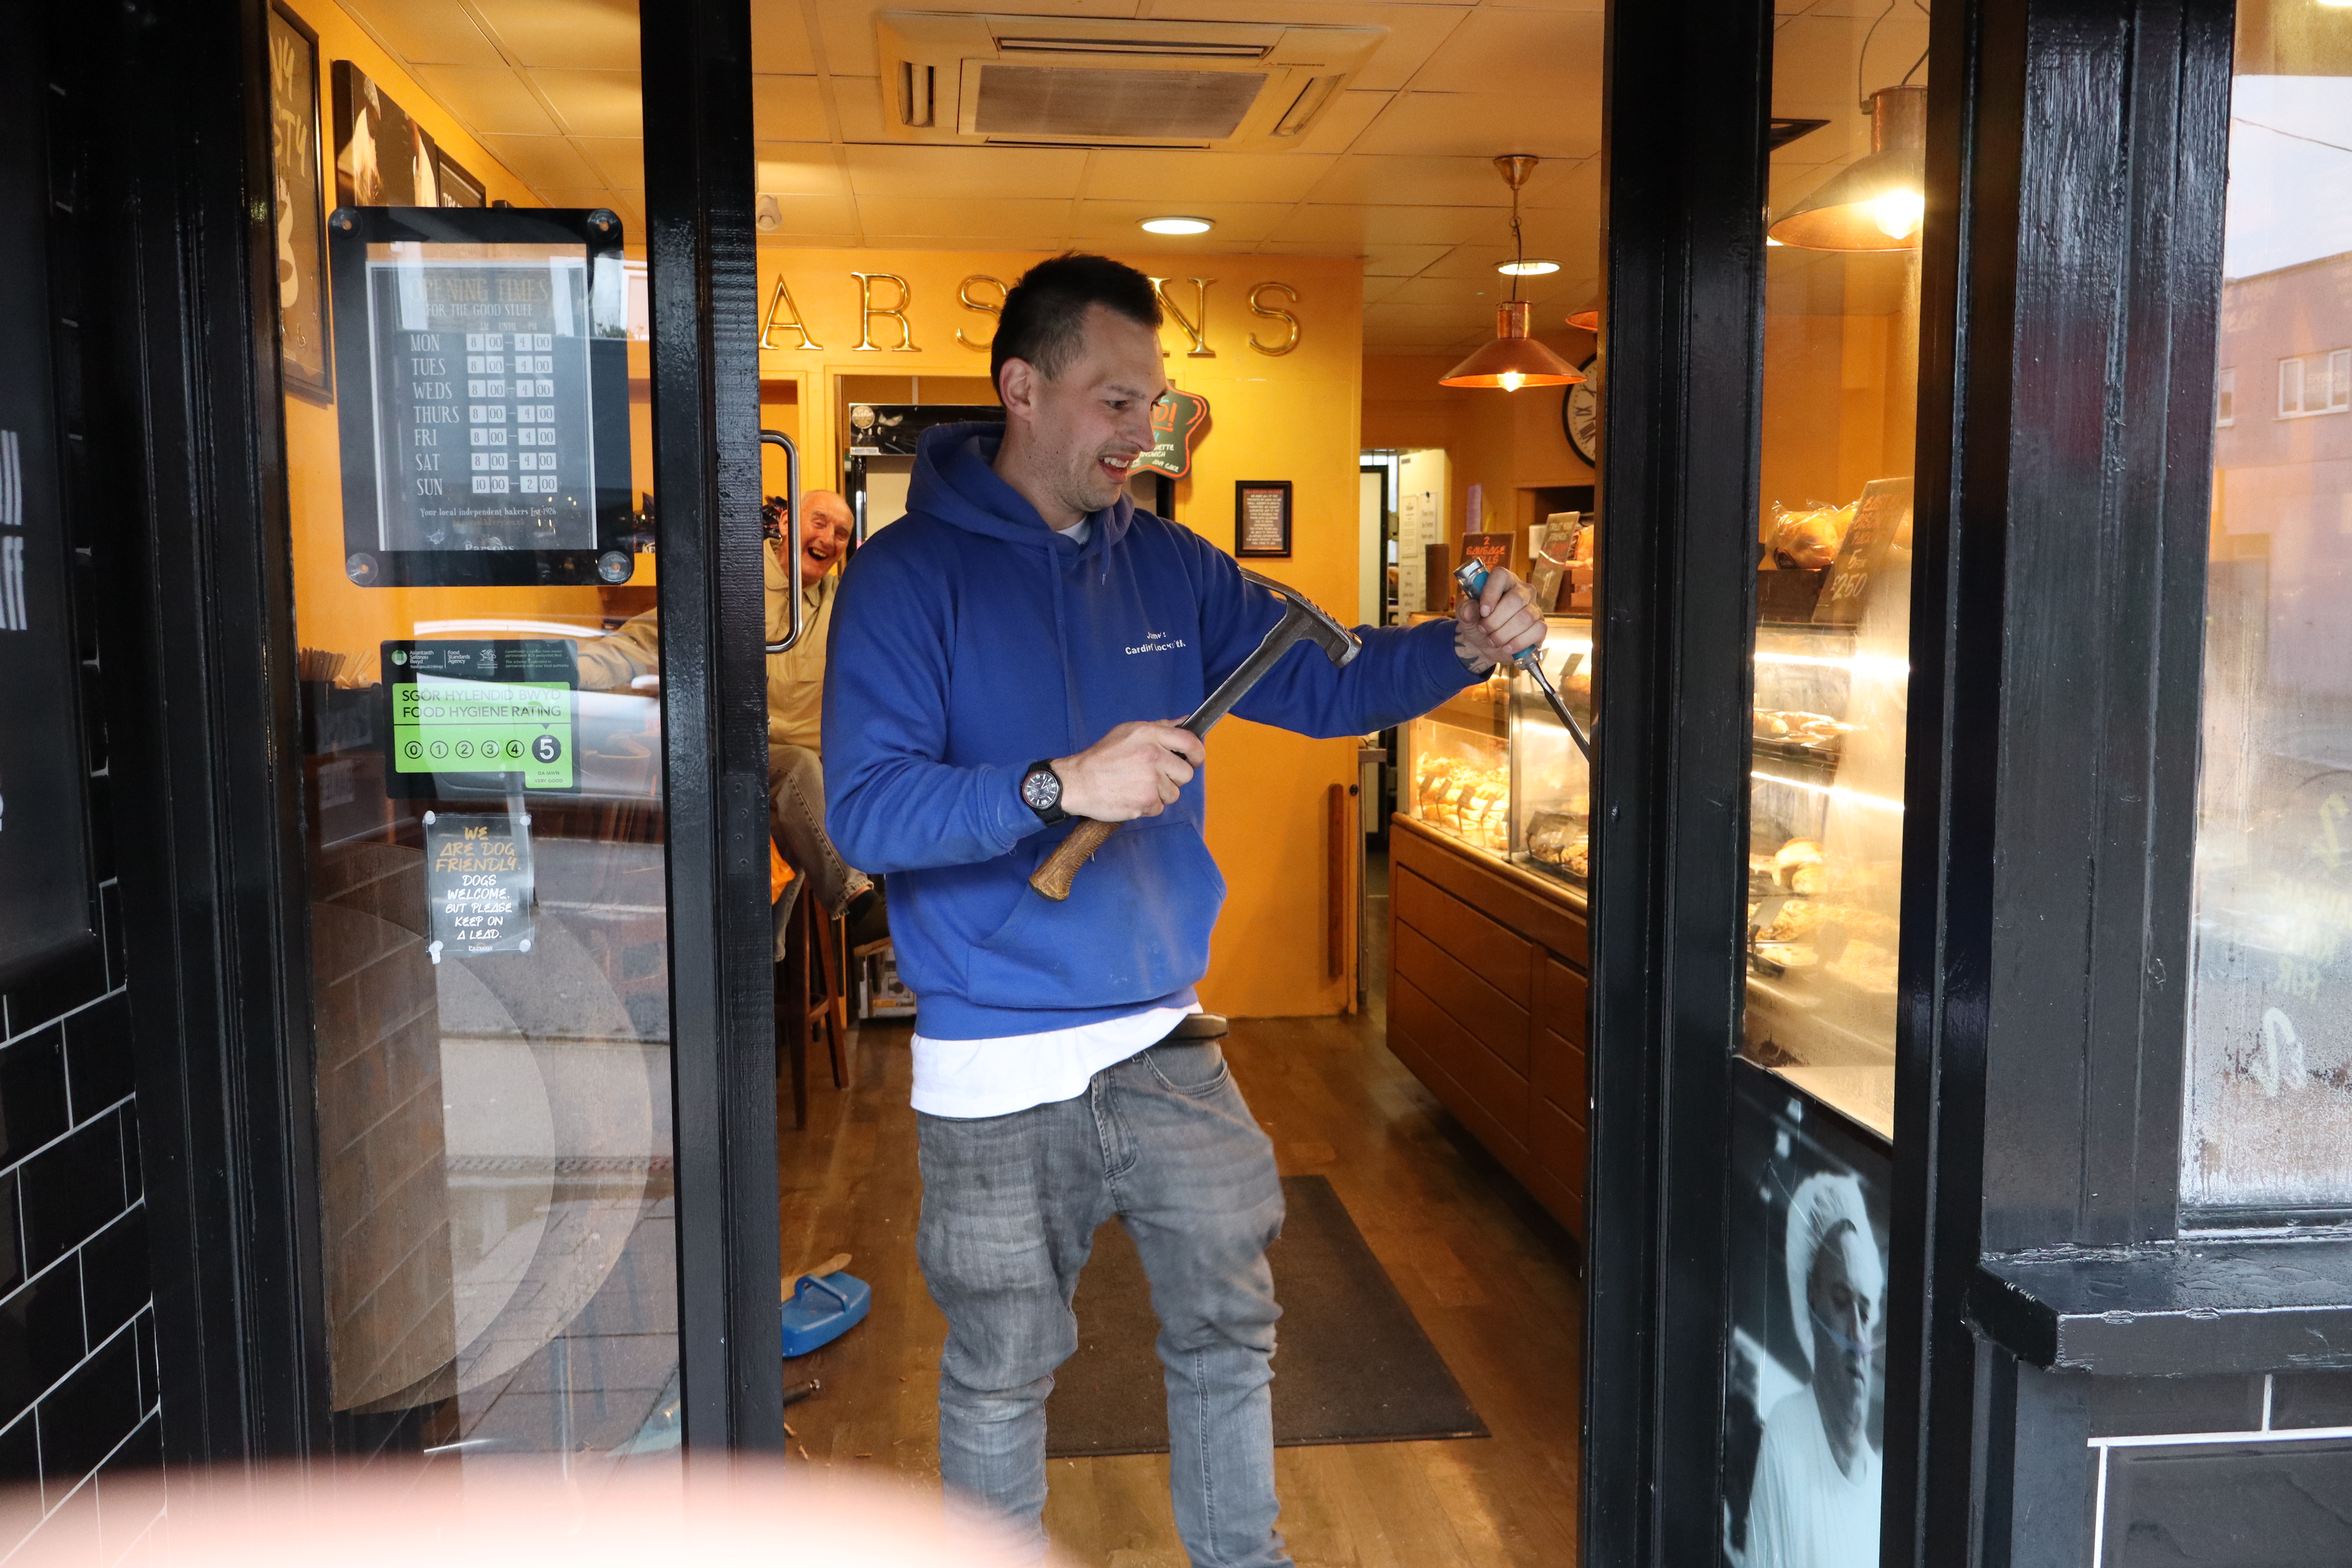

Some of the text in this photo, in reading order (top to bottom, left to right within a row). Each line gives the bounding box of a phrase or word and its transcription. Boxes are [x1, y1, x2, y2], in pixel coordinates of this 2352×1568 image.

[410, 278, 551, 302] OPENING TIMES
[426, 304, 533, 317] FOR THE GOOD STUFF
[759, 273, 1303, 358] ARSNS
[528, 322, 537, 331] PM
[410, 334, 550, 352] MON 8 00 4 00
[411, 358, 549, 376] TUES 8 00 4 00
[412, 382, 550, 399] WEDS 8 00 4 00
[413, 406, 553, 424] THURS 8 00 4 00
[414, 429, 554, 446] FRI 8 00 4 00
[416, 453, 553, 471] SAT 8 00 4 00
[416, 478, 555, 495] SUN 10 00 2 00
[419, 508, 437, 517] Your
[459, 508, 502, 517] independent
[1483, 536, 1490, 545] 2
[1466, 546, 1506, 555] SAUSAGE
[402, 686, 561, 701] SGÔR HYLENDID BWYD
[403, 706, 561, 718] FOOD HYGIENE RATING
[410, 745, 418, 755] 0
[461, 744, 468, 754] 2
[486, 744, 494, 754] 3
[511, 744, 519, 754] 4
[539, 739, 554, 760] 5
[464, 826, 489, 840] WE
[439, 842, 515, 856] ARE DOG
[436, 857, 521, 873] FRIENDLY.
[462, 874, 497, 887] DOGS
[447, 888, 510, 900] WELCOME.
[445, 902, 512, 913] BUT PLEASE
[455, 916, 503, 927] KEEP ON
[457, 929, 502, 940] A LEAD.
